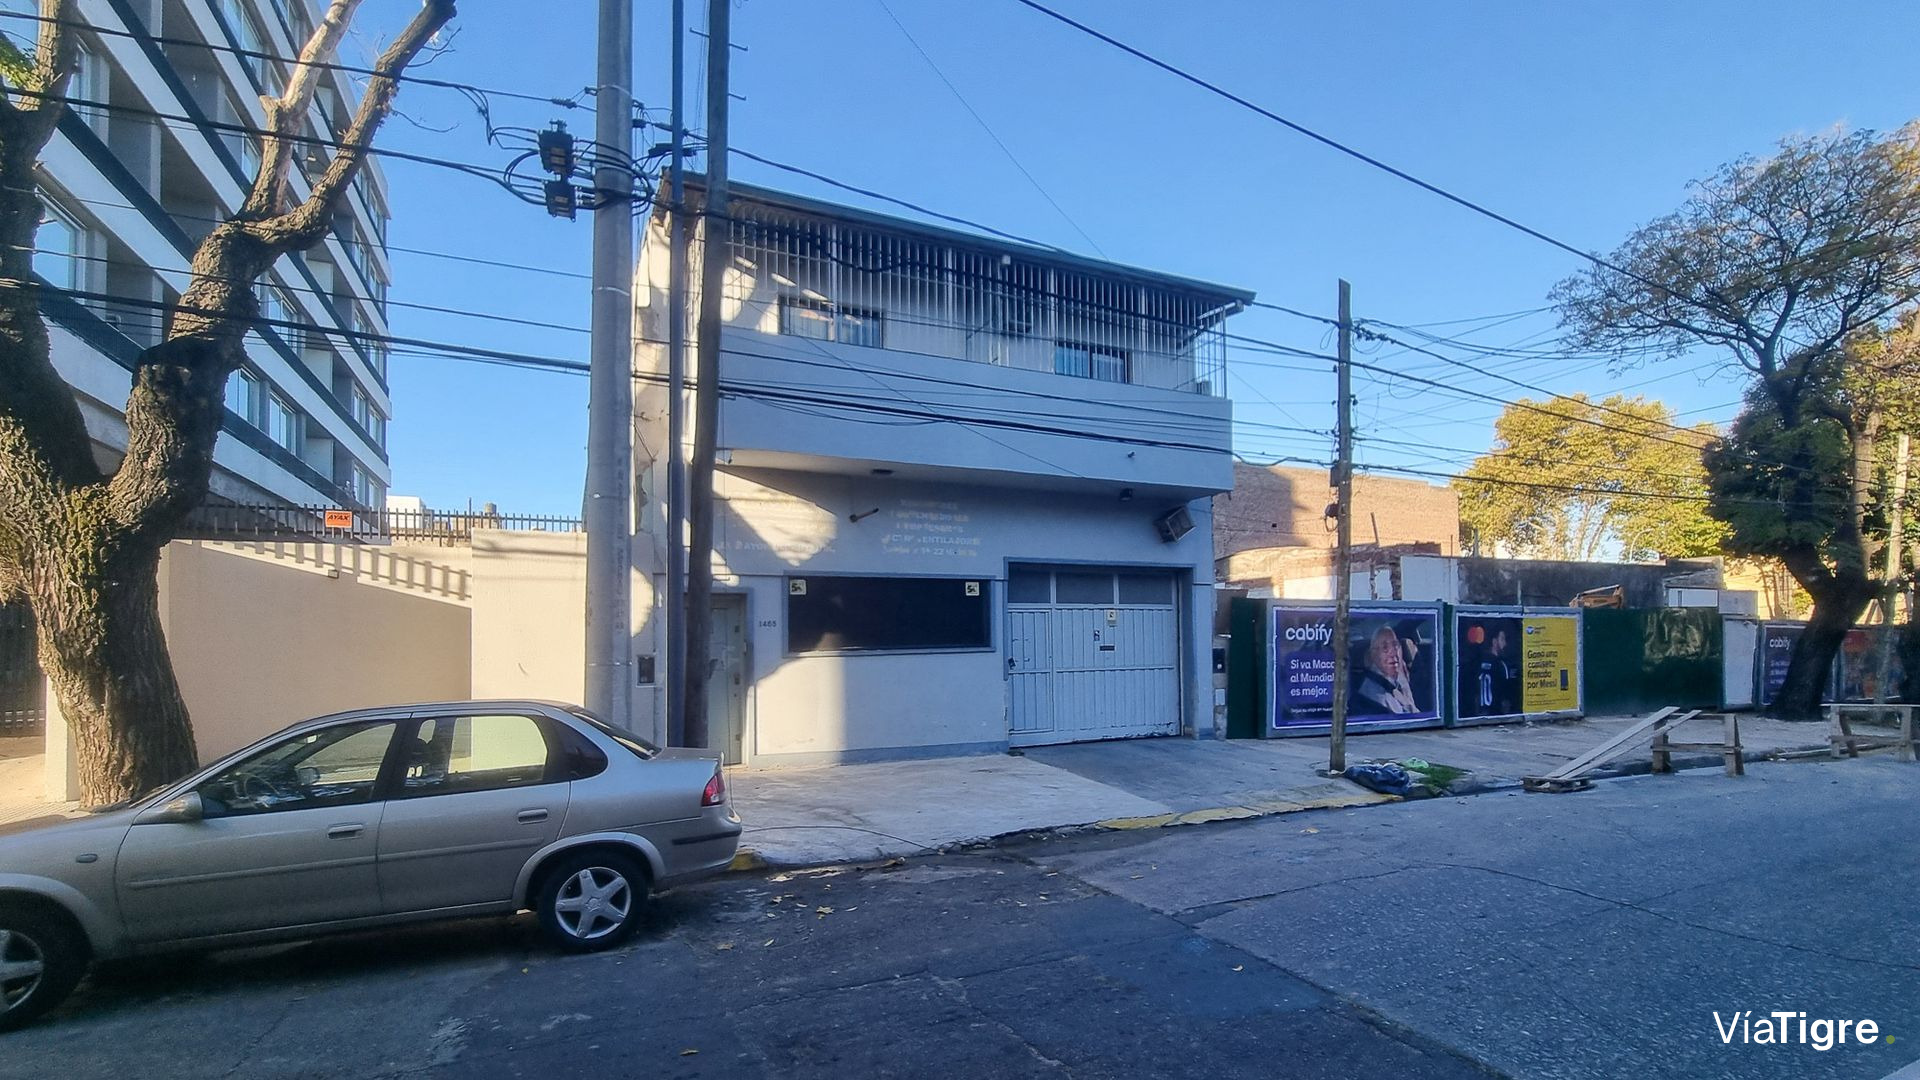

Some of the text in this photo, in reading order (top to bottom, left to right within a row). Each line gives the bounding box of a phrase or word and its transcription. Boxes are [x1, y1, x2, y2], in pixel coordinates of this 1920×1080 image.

[1285, 623, 1332, 645] cabify
[1769, 636, 1791, 650] cabify
[1290, 659, 1299, 669] Si
[1300, 661, 1311, 669] va
[1290, 672, 1335, 682] al Mundial
[1290, 685, 1328, 697] es mejor.
[1478, 672, 1493, 707] 10
[1527, 681, 1539, 690] por
